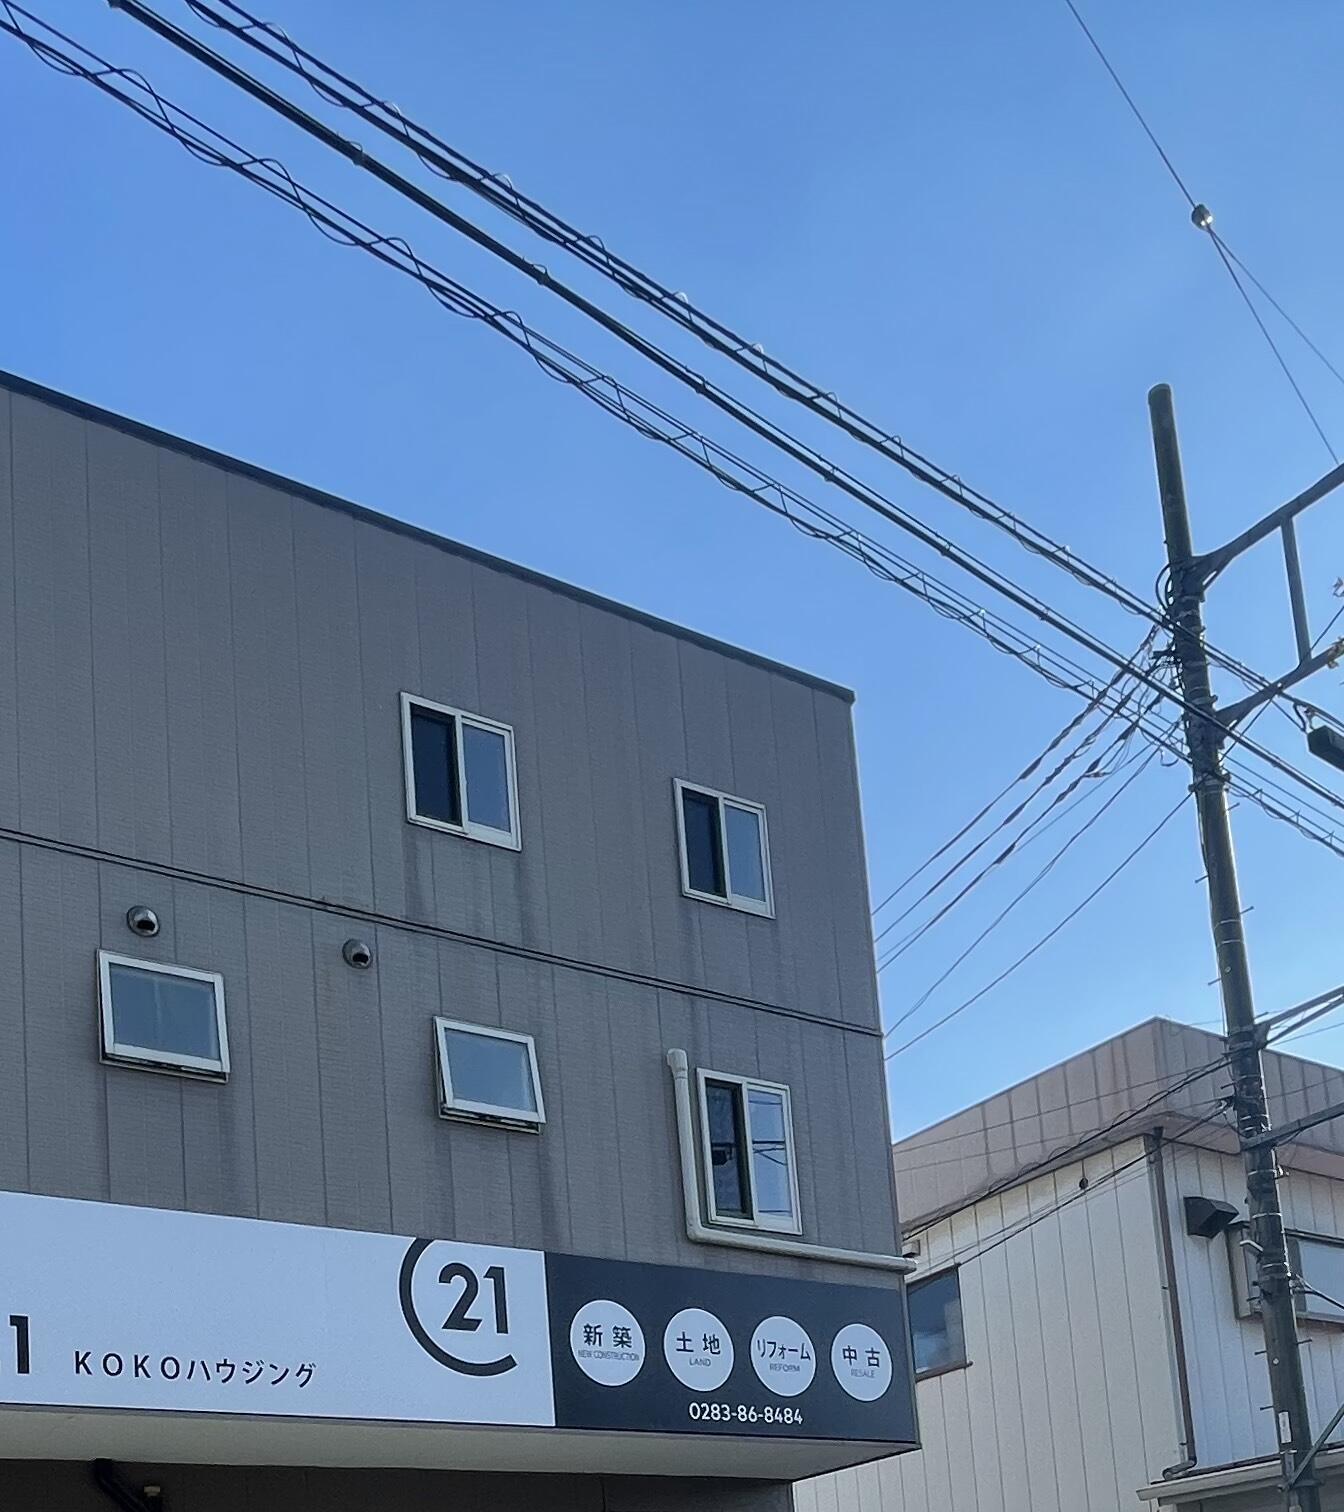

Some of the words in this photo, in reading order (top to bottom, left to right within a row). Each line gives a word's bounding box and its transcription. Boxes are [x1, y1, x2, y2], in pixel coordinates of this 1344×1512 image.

[582, 1323, 633, 1349] 新築
[675, 1331, 721, 1356] 土地
[757, 1338, 811, 1361] リフォーム
[842, 1344, 881, 1368] 中古
[74, 1350, 317, 1388] KOKOハウジング
[689, 1357, 712, 1367] LAND
[769, 1362, 801, 1373] REFORM
[850, 1368, 876, 1378] RESALE
[689, 1402, 804, 1425] 0283-86-8484
